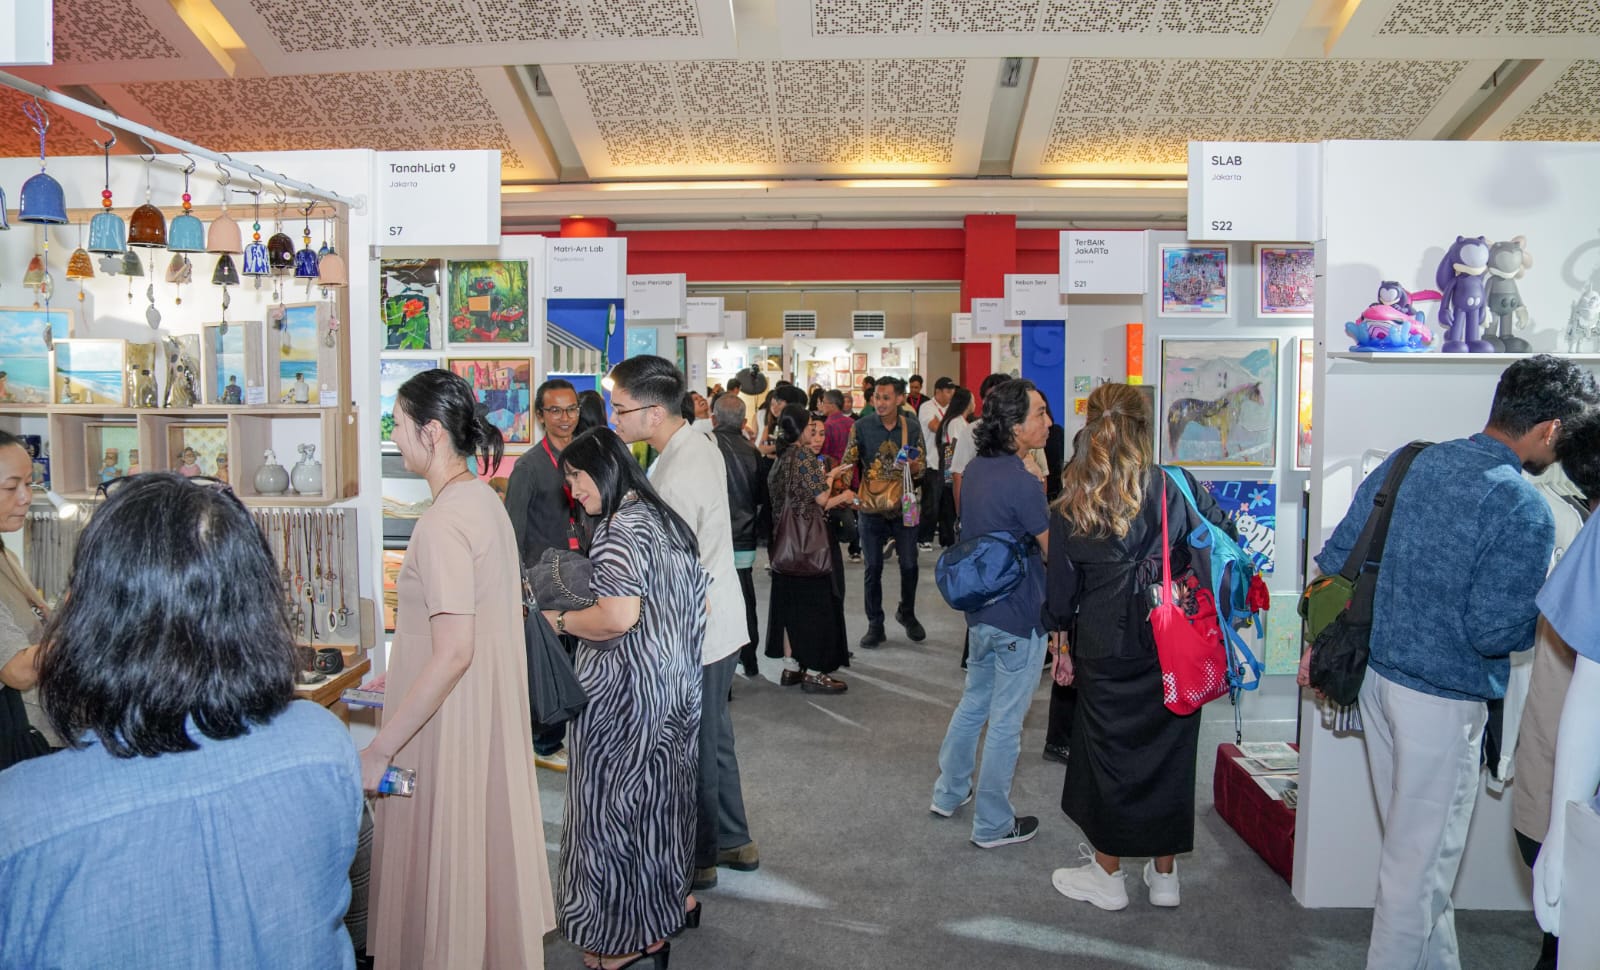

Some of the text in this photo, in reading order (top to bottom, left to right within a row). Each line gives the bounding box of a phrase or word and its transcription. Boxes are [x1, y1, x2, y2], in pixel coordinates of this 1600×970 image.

[1211, 155, 1243, 166] SLAB
[389, 162, 456, 174] TanahLiat 9
[389, 180, 418, 188] Jakarta
[389, 225, 404, 237] S7
[1211, 220, 1233, 231] S22
[1074, 238, 1106, 246] TerBAIK
[1073, 280, 1087, 288] S21
